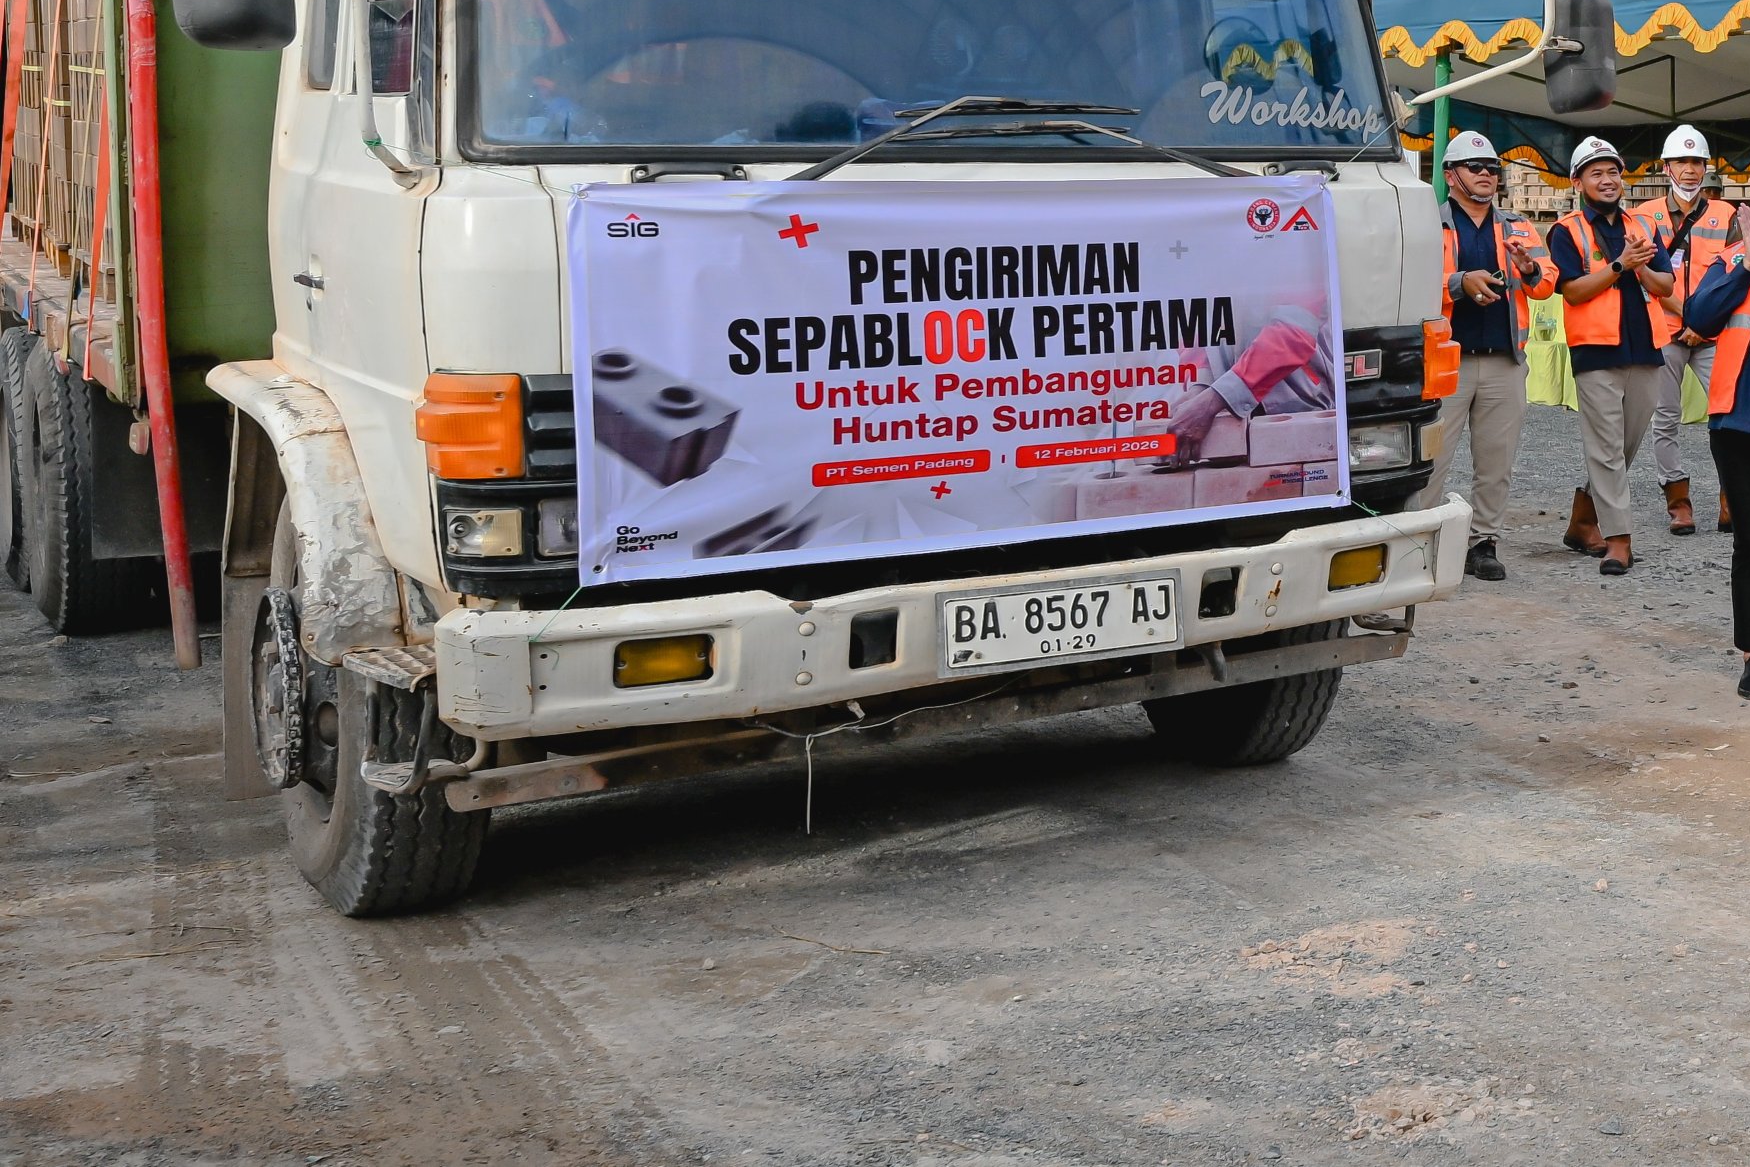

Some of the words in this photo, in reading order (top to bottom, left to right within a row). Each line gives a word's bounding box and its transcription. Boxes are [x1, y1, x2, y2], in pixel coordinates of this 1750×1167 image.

[1200, 80, 1385, 135] Workshop
[607, 220, 660, 238] SIG
[848, 241, 1140, 305] PENGIRIMAN
[727, 307, 1018, 376] SEPABLOCK
[1033, 296, 1236, 358] PERTAMA
[795, 376, 921, 410] Untuk
[935, 363, 1197, 401] Pembangunan
[833, 413, 979, 445] Huntap
[992, 399, 1169, 433] Sumatera
[826, 466, 848, 479] PT
[852, 461, 910, 477] Semen
[914, 454, 976, 472] Padang
[1033, 449, 1052, 460] 12
[1055, 441, 1117, 457] Februari
[1121, 440, 1160, 452] 2026
[616, 525, 640, 535] Go
[616, 530, 678, 545] Beyond
[616, 542, 655, 553] Next
[954, 602, 1001, 643] BA
[1025, 591, 1110, 634] 8567
[1132, 584, 1171, 624] AJ
